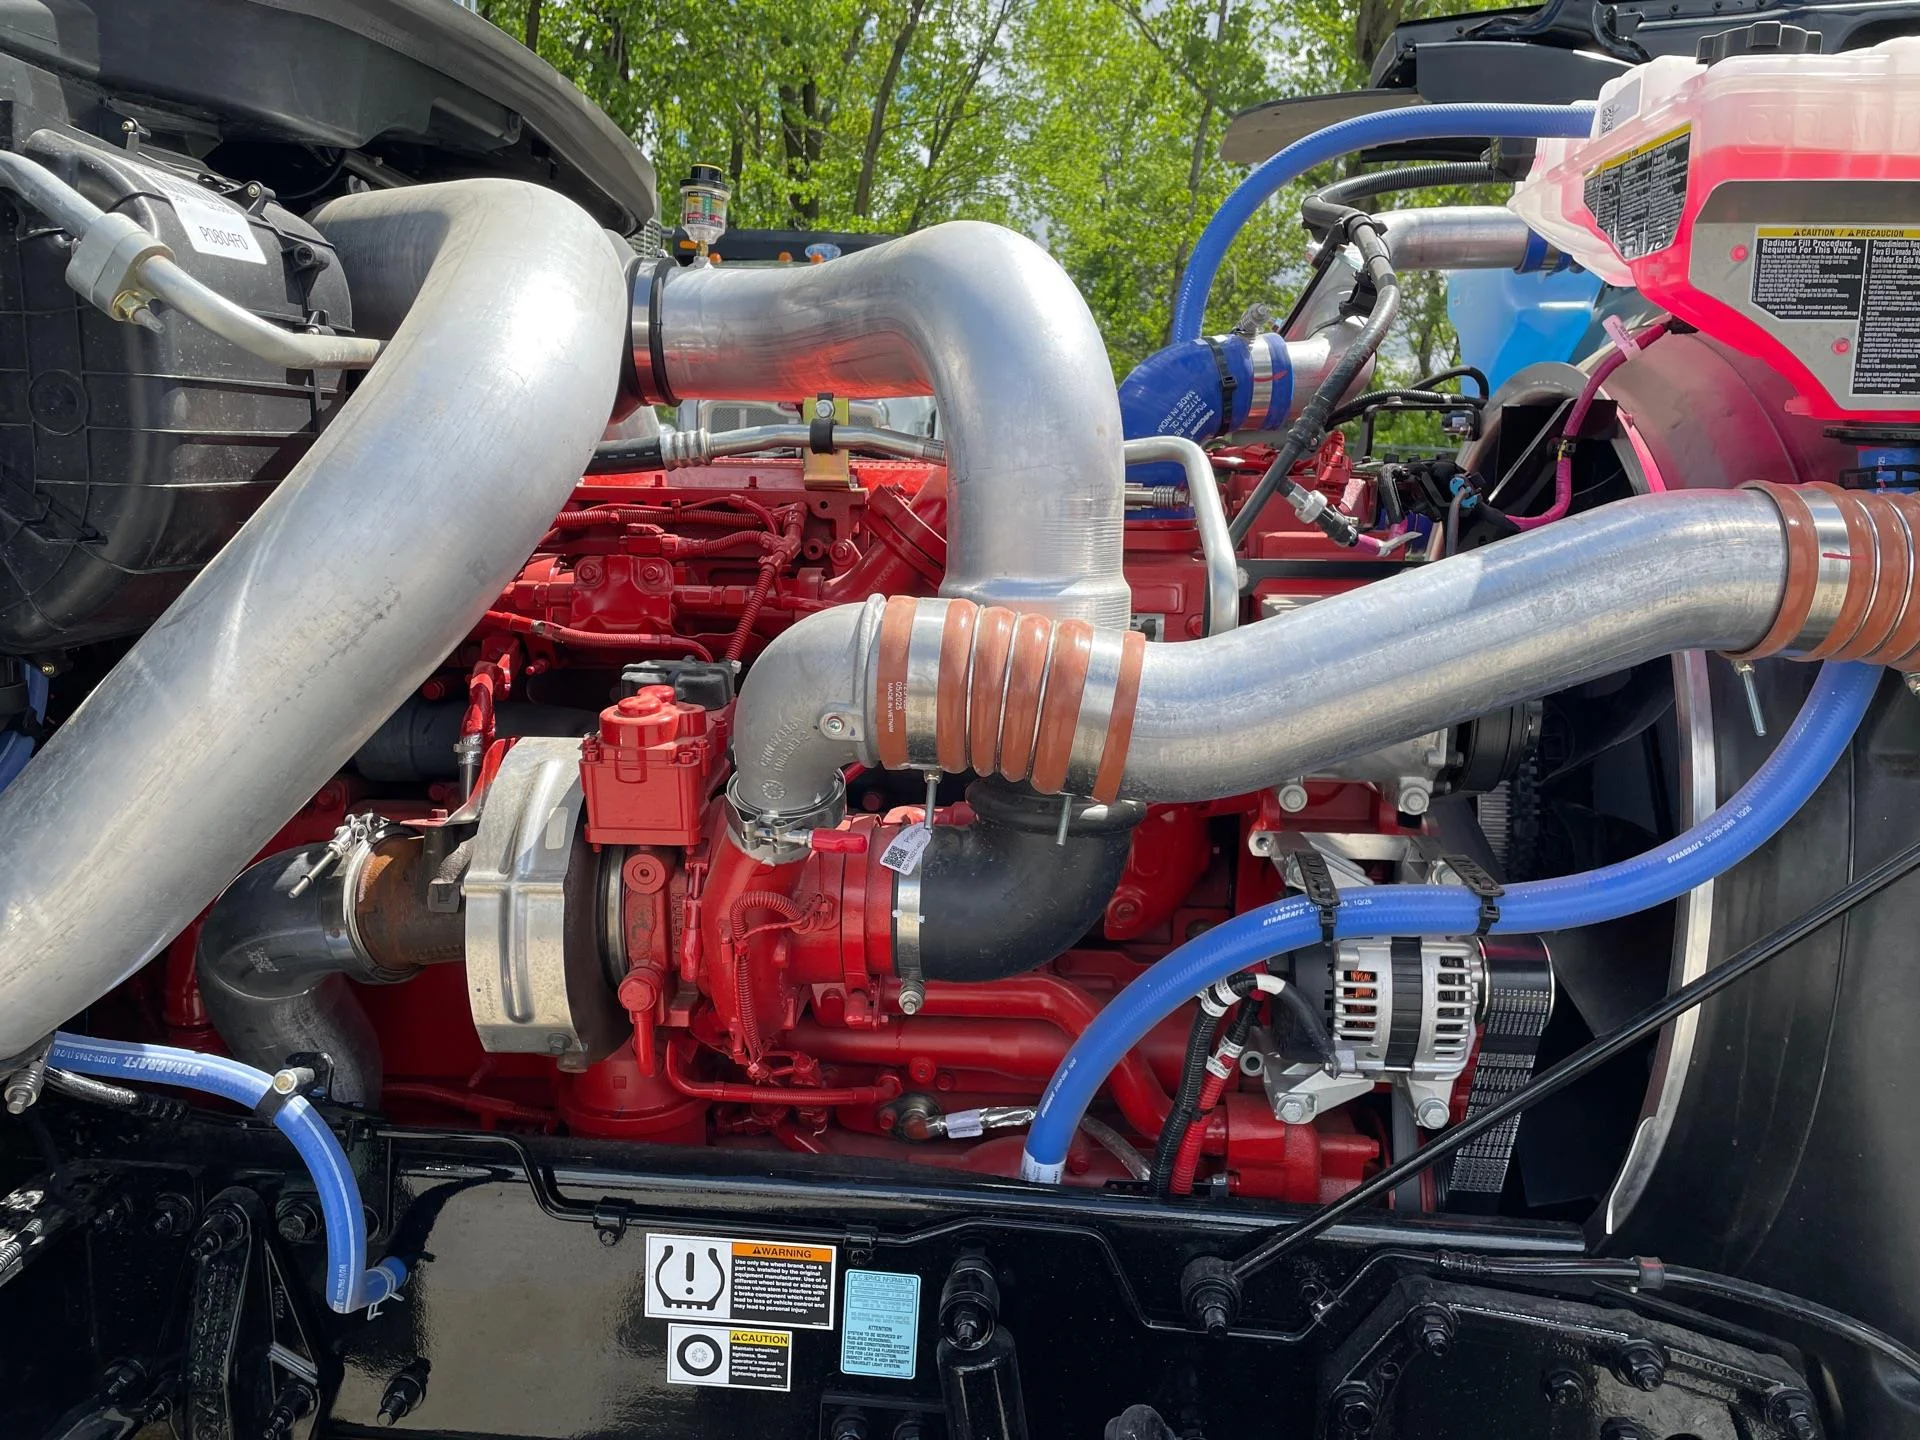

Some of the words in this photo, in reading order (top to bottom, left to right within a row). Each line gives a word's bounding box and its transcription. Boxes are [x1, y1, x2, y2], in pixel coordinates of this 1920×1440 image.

[1177, 391, 1195, 409] MADE
[1171, 408, 1179, 416] IN
[1157, 415, 1173, 432] INDIA
[762, 1248, 811, 1258] WARNING
[741, 1334, 787, 1344] CAUTION
